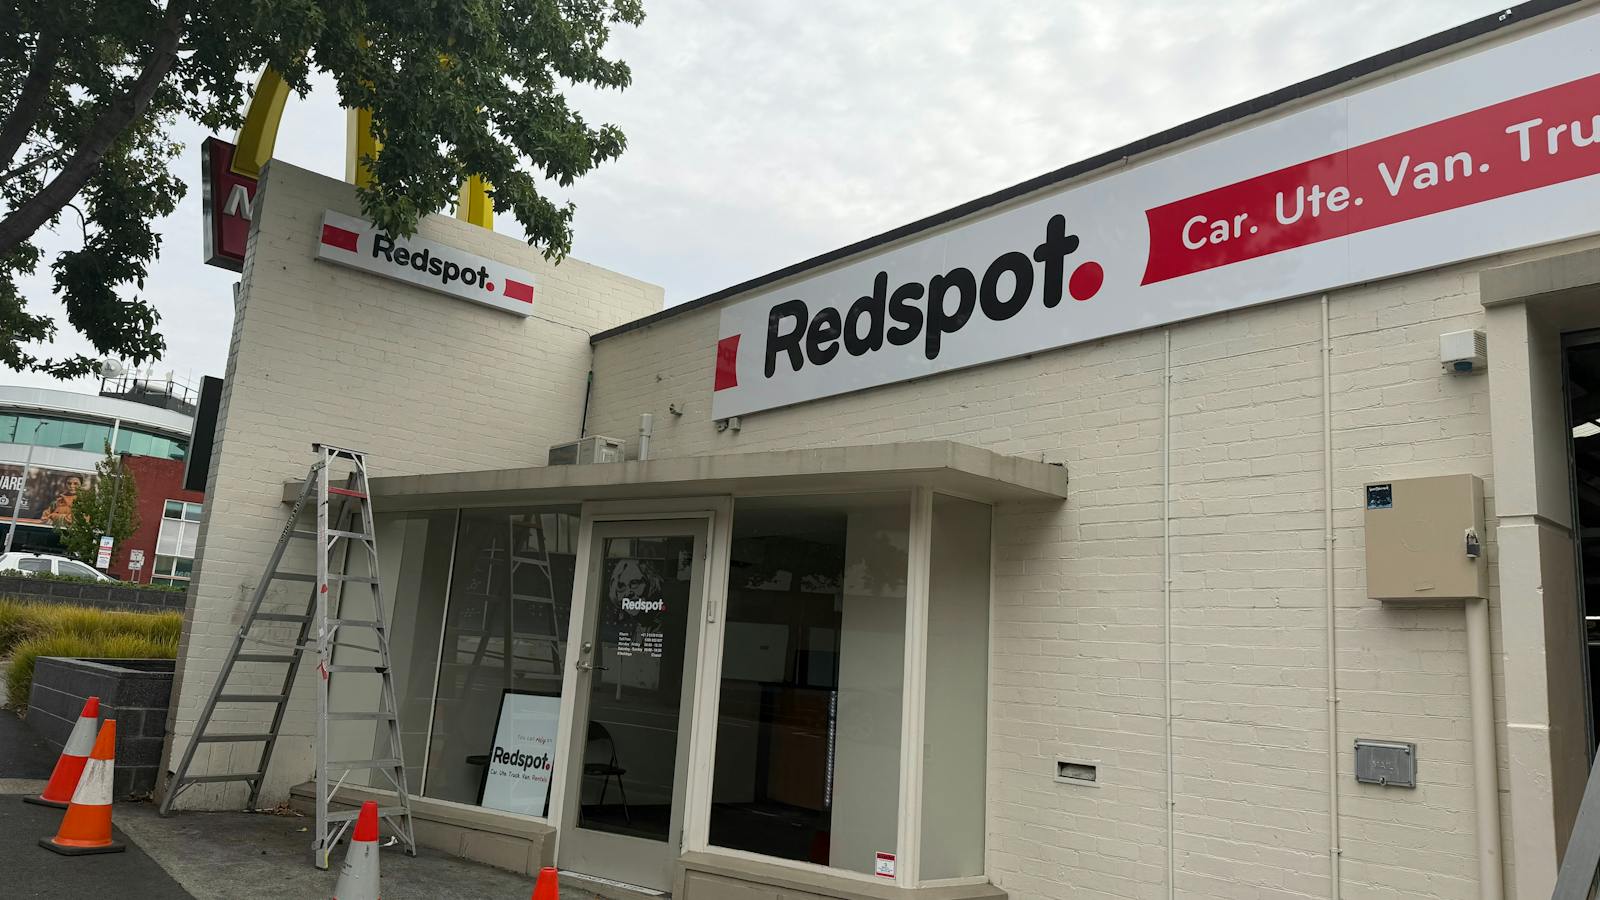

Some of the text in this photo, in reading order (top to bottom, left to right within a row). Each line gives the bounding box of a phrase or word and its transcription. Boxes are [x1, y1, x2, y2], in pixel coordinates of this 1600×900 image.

[1181, 211, 1258, 250] Car.
[1275, 185, 1364, 226] Ute.
[1378, 150, 1490, 197] Van.
